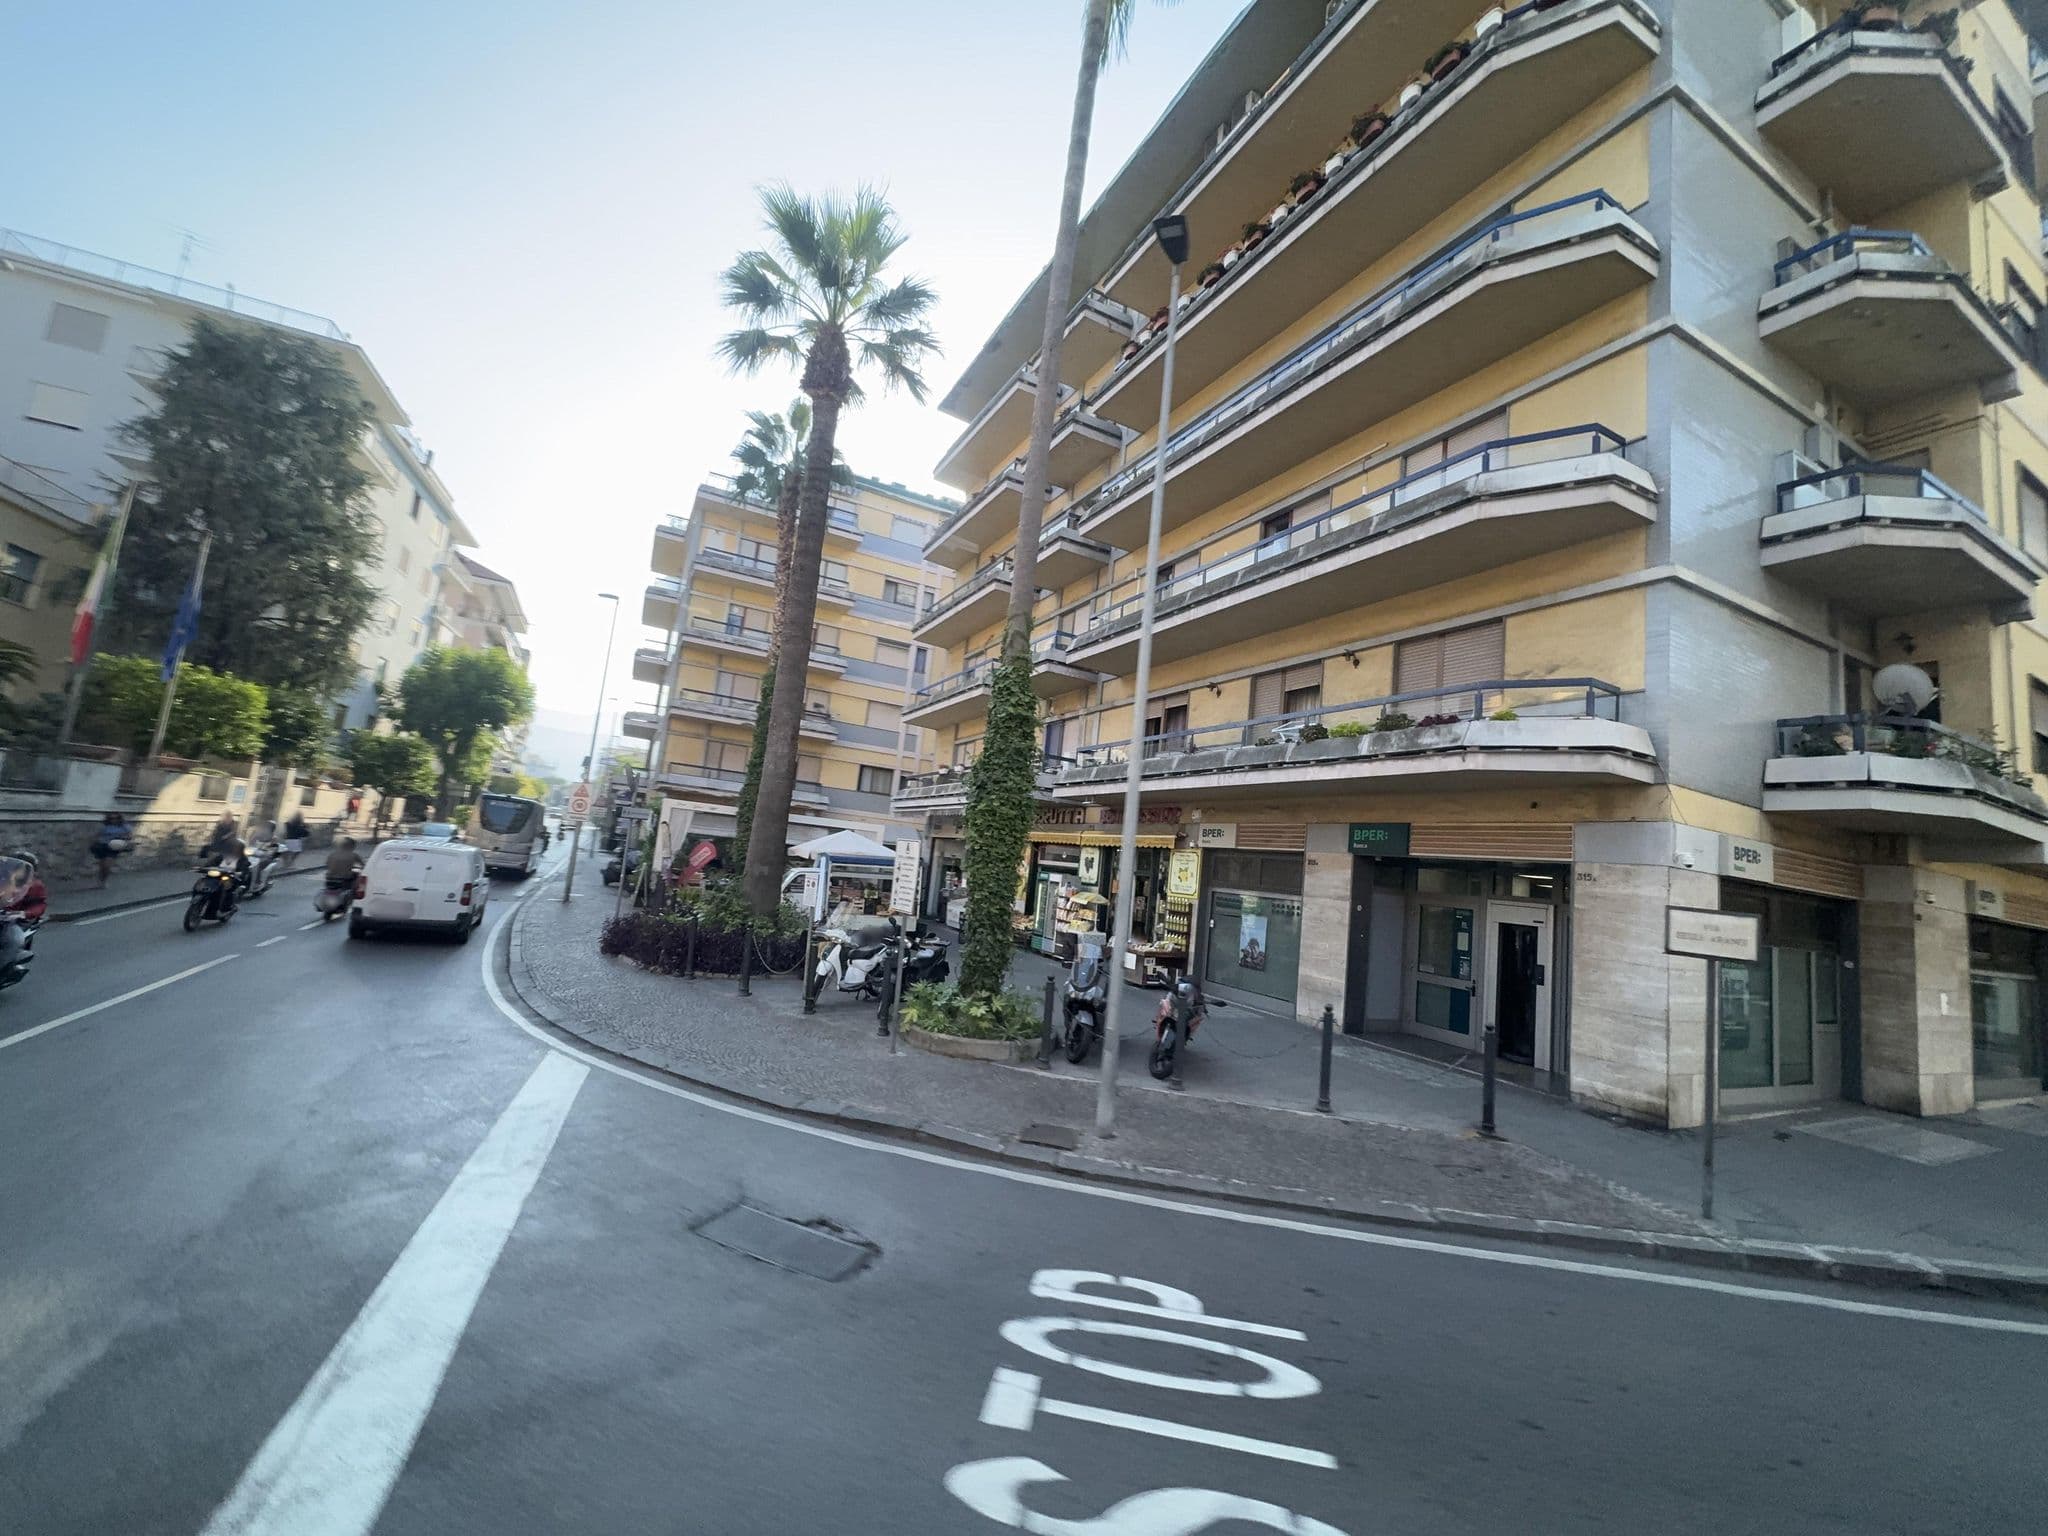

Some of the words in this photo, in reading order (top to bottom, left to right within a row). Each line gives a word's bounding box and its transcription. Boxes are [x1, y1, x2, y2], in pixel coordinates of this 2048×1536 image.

[1202, 828, 1225, 838] BPER:
[1353, 829, 1389, 841] BPER:
[1734, 846, 1761, 864] BPER:
[943, 1268, 1350, 1536] STOP
